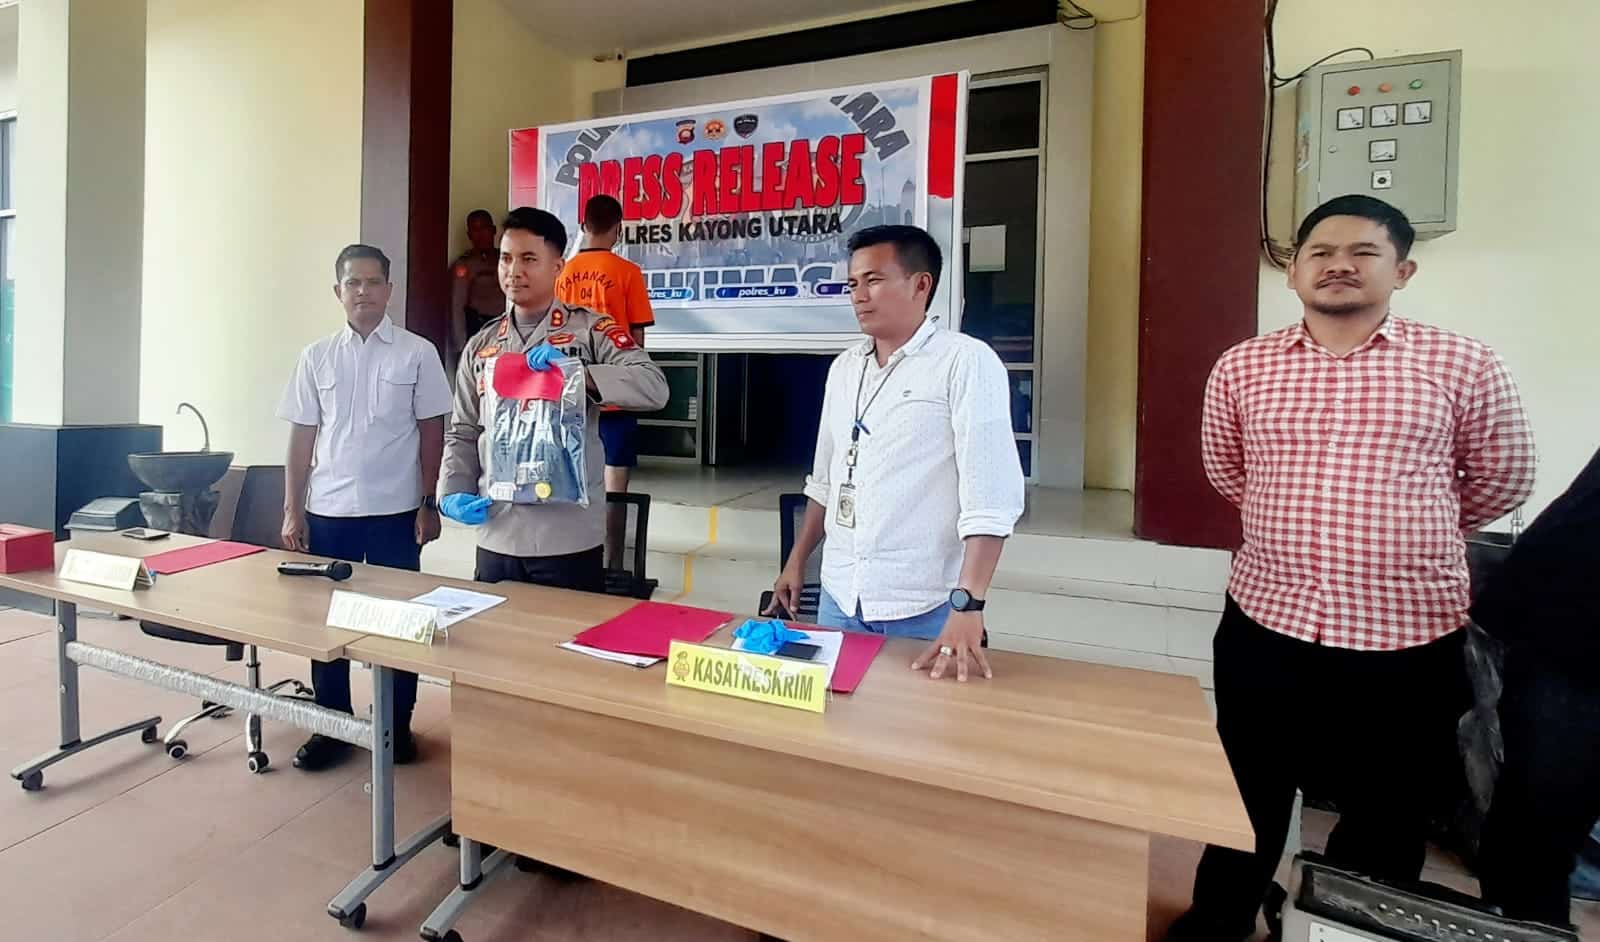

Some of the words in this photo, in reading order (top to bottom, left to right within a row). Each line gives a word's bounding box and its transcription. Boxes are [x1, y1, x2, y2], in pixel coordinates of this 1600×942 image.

[577, 151, 685, 225] PRESS
[692, 133, 867, 217] RELEASE
[619, 210, 673, 245] LRES
[678, 217, 763, 242] KAYONG
[769, 212, 843, 237] UTARA
[580, 287, 593, 300] 04
[692, 655, 815, 702] KASATRESKRIM
